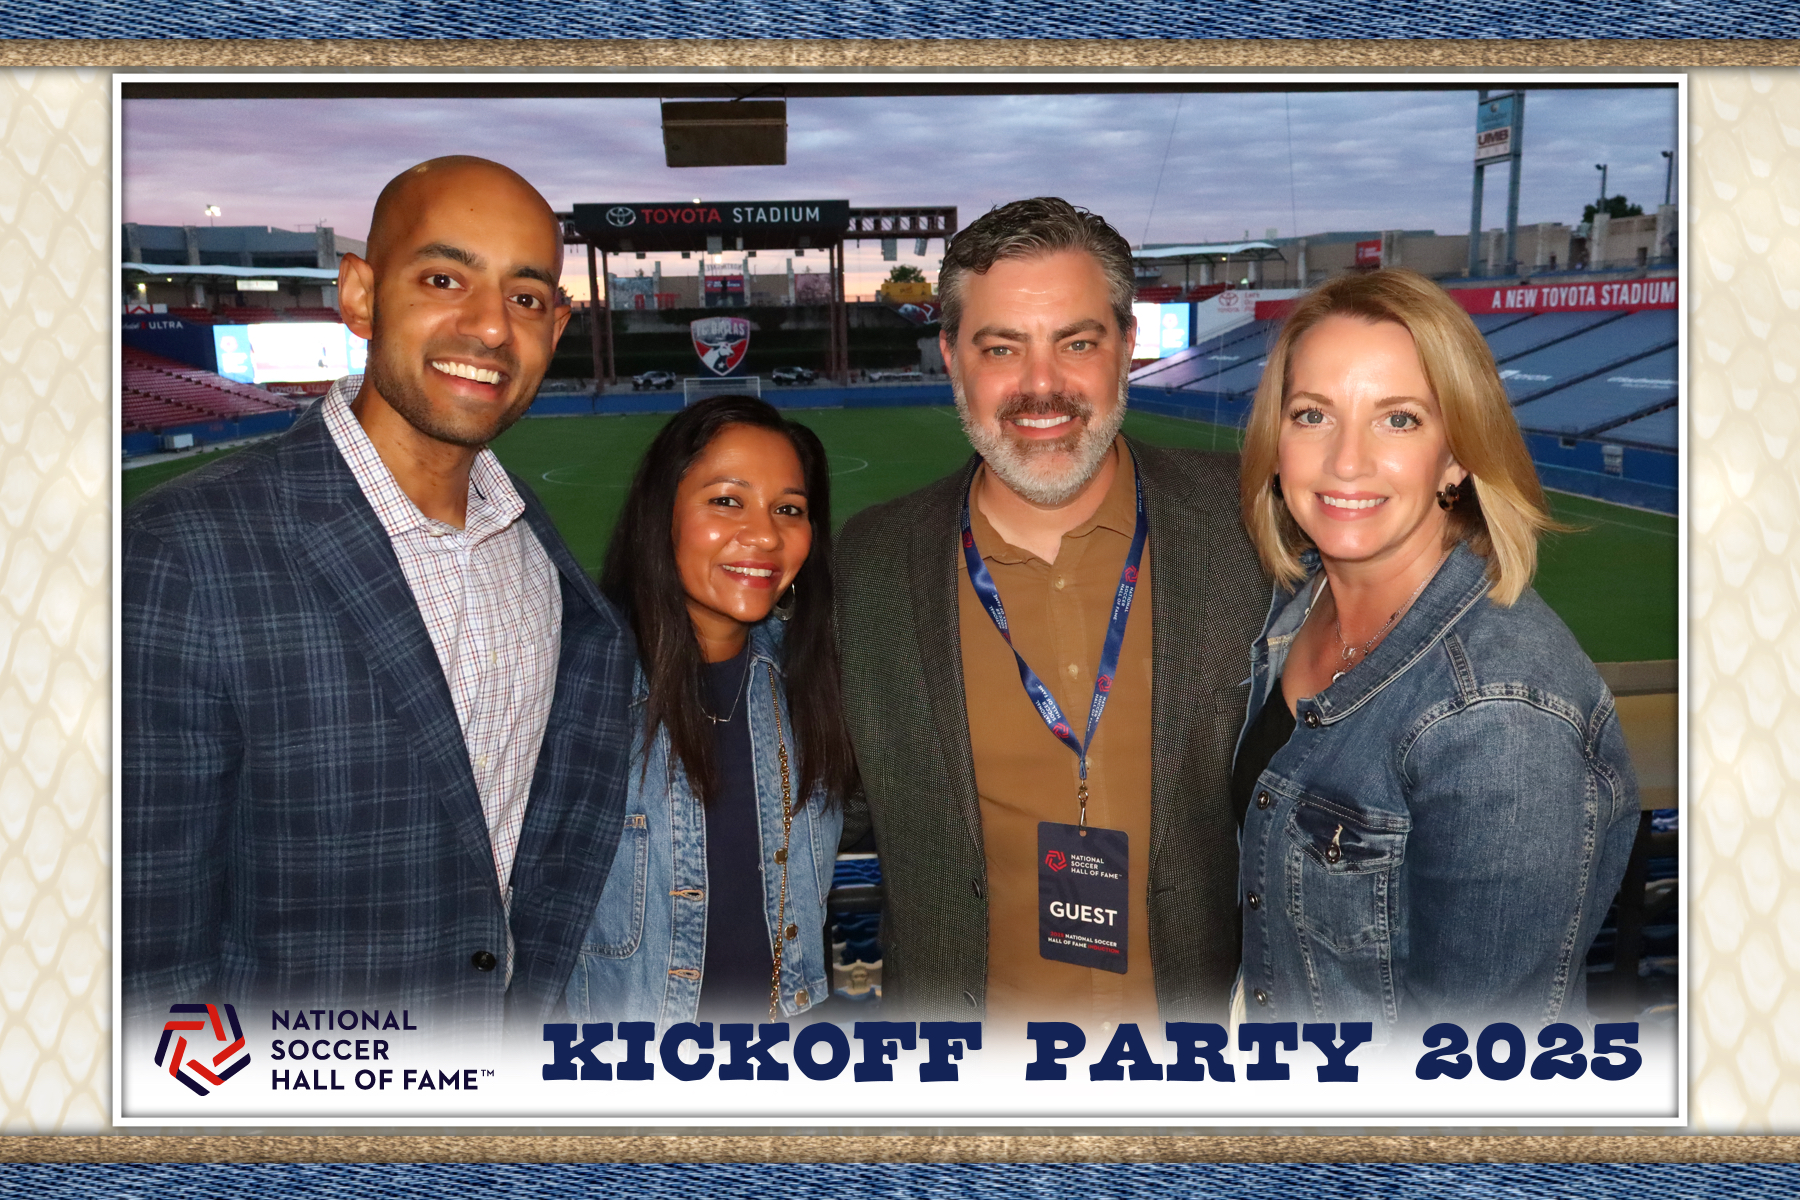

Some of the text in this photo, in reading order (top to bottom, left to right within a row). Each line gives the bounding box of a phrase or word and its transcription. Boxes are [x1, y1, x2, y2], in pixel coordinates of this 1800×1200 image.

[1477, 128, 1509, 146] UMB
[641, 206, 820, 224] TOYOTA STADIUM
[1491, 281, 1677, 309] A NEW TOYOTA STADIUM
[148, 320, 184, 330] ULTRA
[1117, 583, 1125, 597] HALL
[1121, 585, 1130, 607] SOCCER
[1116, 598, 1121, 606] OF
[1124, 586, 1134, 613] NATIONAL
[1035, 700, 1052, 724] NATIONAL
[1042, 701, 1056, 722] SOCCER
[1052, 705, 1061, 719] HALL
[1070, 854, 1105, 864] NATIONAL
[1070, 861, 1099, 870] SOCCER
[1070, 867, 1088, 875] HALL
[1049, 901, 1118, 927] GUEST
[1065, 933, 1093, 943] NATIONAL
[1094, 938, 1118, 948] SOCCER
[1072, 941, 1087, 949] FAME
[1087, 944, 1120, 954] INDUCTION
